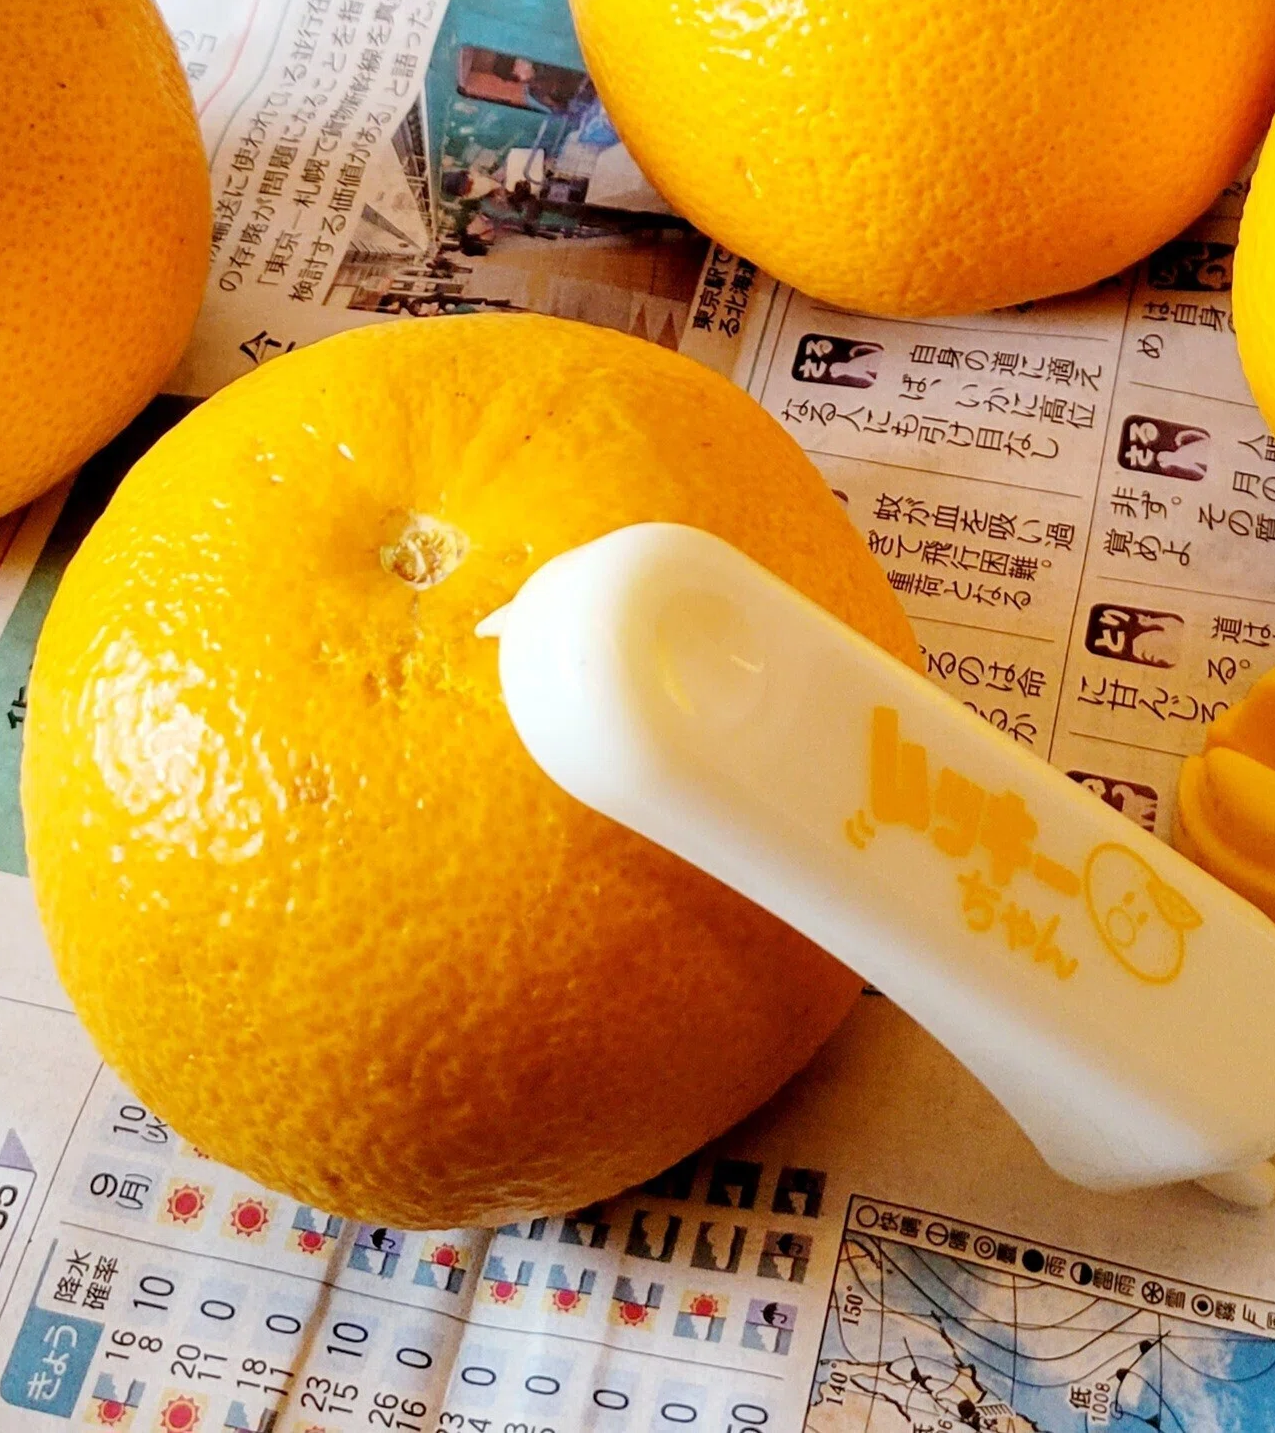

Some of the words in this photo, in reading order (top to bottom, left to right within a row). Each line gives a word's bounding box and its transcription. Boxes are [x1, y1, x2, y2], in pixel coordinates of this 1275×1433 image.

[1143, 301, 1235, 334] は自身
[1136, 333, 1164, 360] め
[910, 344, 1102, 392] 自身の道に適え
[781, 398, 1059, 460] なる人にも引け目なし
[872, 493, 1075, 551] 蚊が血を吸い過
[868, 528, 1053, 581] ぎて飛行困難。
[1104, 529, 1191, 567] 覚めよ
[922, 649, 1047, 697] るのは命
[113, 1105, 146, 1134] 10
[90, 1173, 118, 1197] 9
[115, 1173, 152, 1211] (月)
[54, 1249, 92, 1304] 降水
[82, 1255, 119, 1310] 確率
[1044, 1256, 1067, 1278] 雨
[133, 1276, 175, 1312] 10
[201, 1299, 235, 1321] 0
[841, 1285, 867, 1328] 150°
[266, 1315, 301, 1335] 0
[327, 1322, 369, 1357] 10
[106, 1329, 137, 1361] 16
[138, 1336, 163, 1353] 8
[396, 1348, 432, 1369] 0
[27, 1323, 78, 1402] きょう
[171, 1344, 201, 1379] 20
[197, 1351, 228, 1382] 11
[237, 1359, 268, 1388] 18
[461, 1367, 496, 1387] 0
[264, 1365, 295, 1396] 11
[301, 1376, 331, 1412] 23
[525, 1375, 560, 1396] 0
[825, 1362, 853, 1408] 140°
[328, 1384, 359, 1416] 15
[369, 1393, 400, 1427] 26
[593, 1389, 630, 1411] 0
[661, 1403, 698, 1424] 0
[1067, 1387, 1093, 1411] 低
[1090, 1381, 1111, 1424] 1008
[396, 1401, 427, 1433] 16
